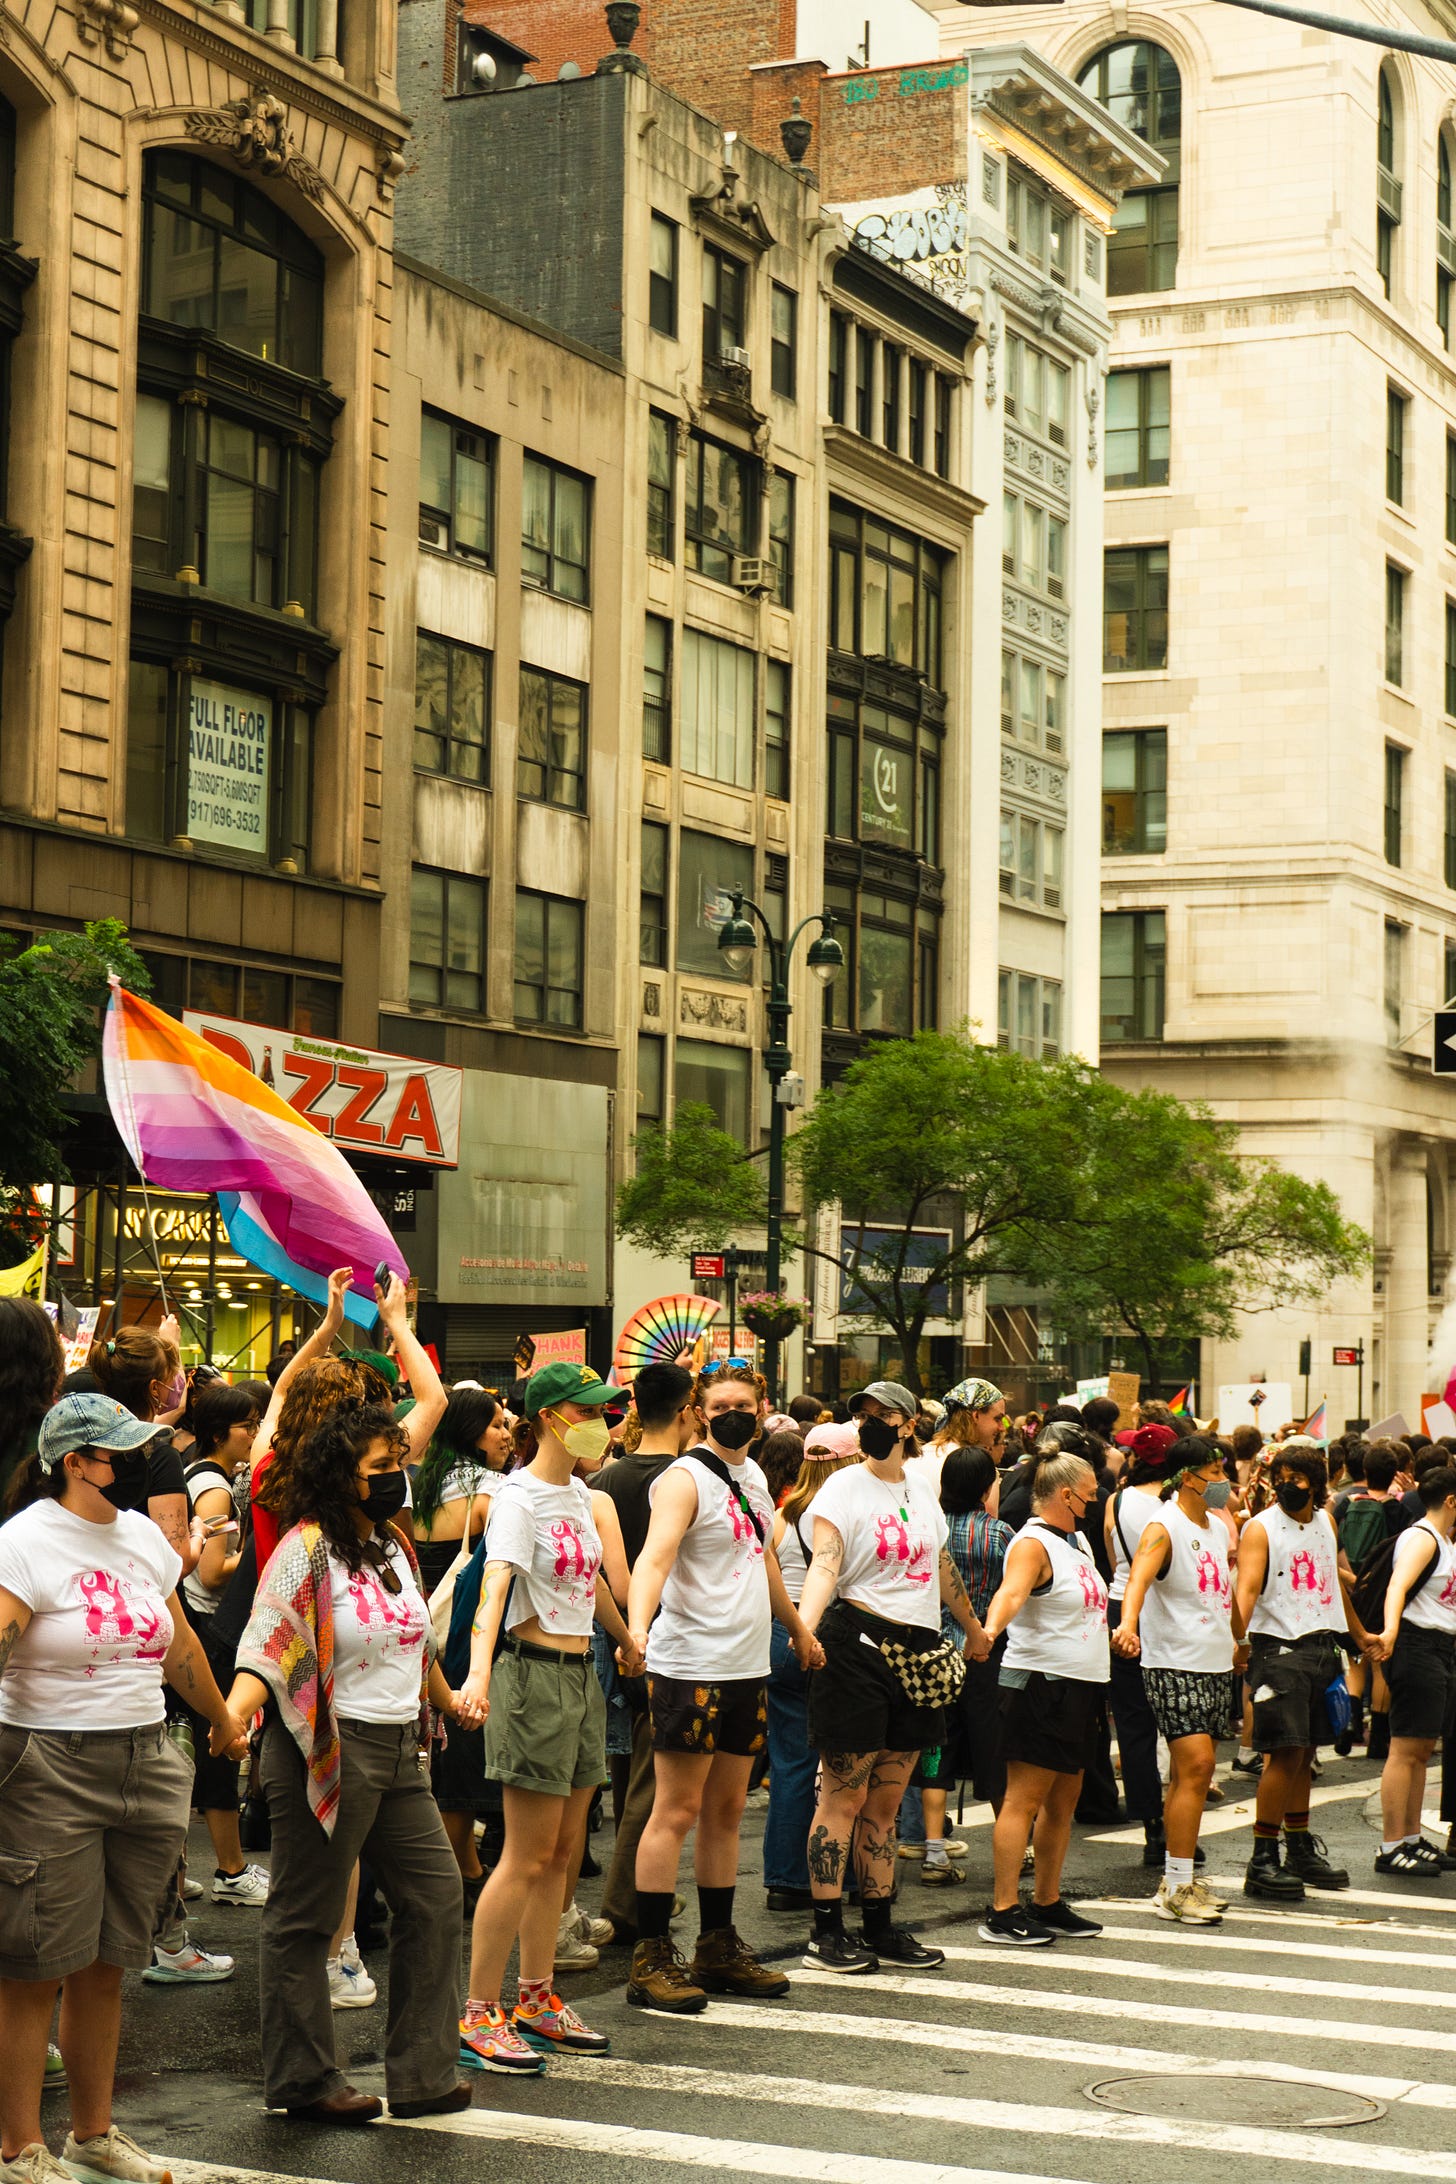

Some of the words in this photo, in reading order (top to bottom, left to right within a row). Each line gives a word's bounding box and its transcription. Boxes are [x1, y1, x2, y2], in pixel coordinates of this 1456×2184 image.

[189, 695, 220, 731] FULL
[223, 704, 265, 743] FLOOR
[189, 729, 264, 776] AVAILABLE
